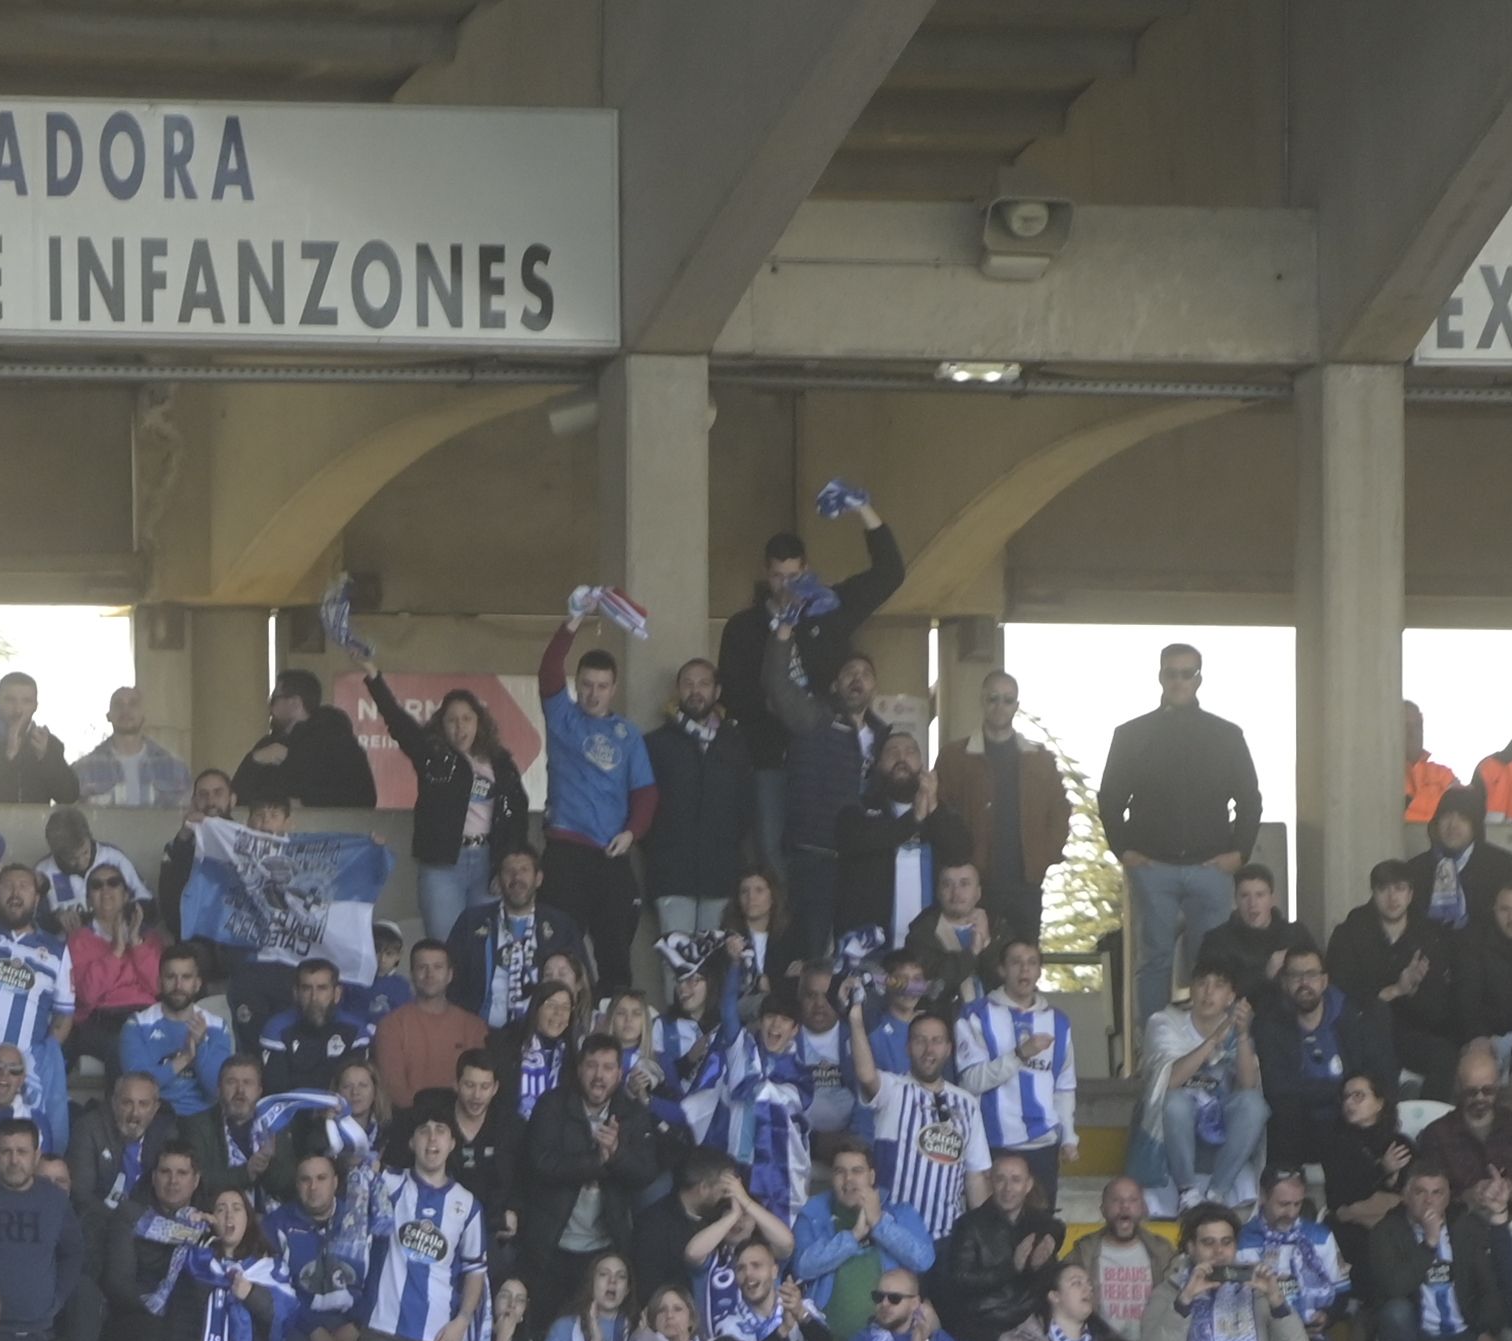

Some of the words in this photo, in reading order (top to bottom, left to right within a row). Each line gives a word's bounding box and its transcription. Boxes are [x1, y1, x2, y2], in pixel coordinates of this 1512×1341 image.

[45, 234, 557, 331] INFANZONES
[402, 1235, 438, 1255] Galicia
[404, 1225, 444, 1246] Estrella
